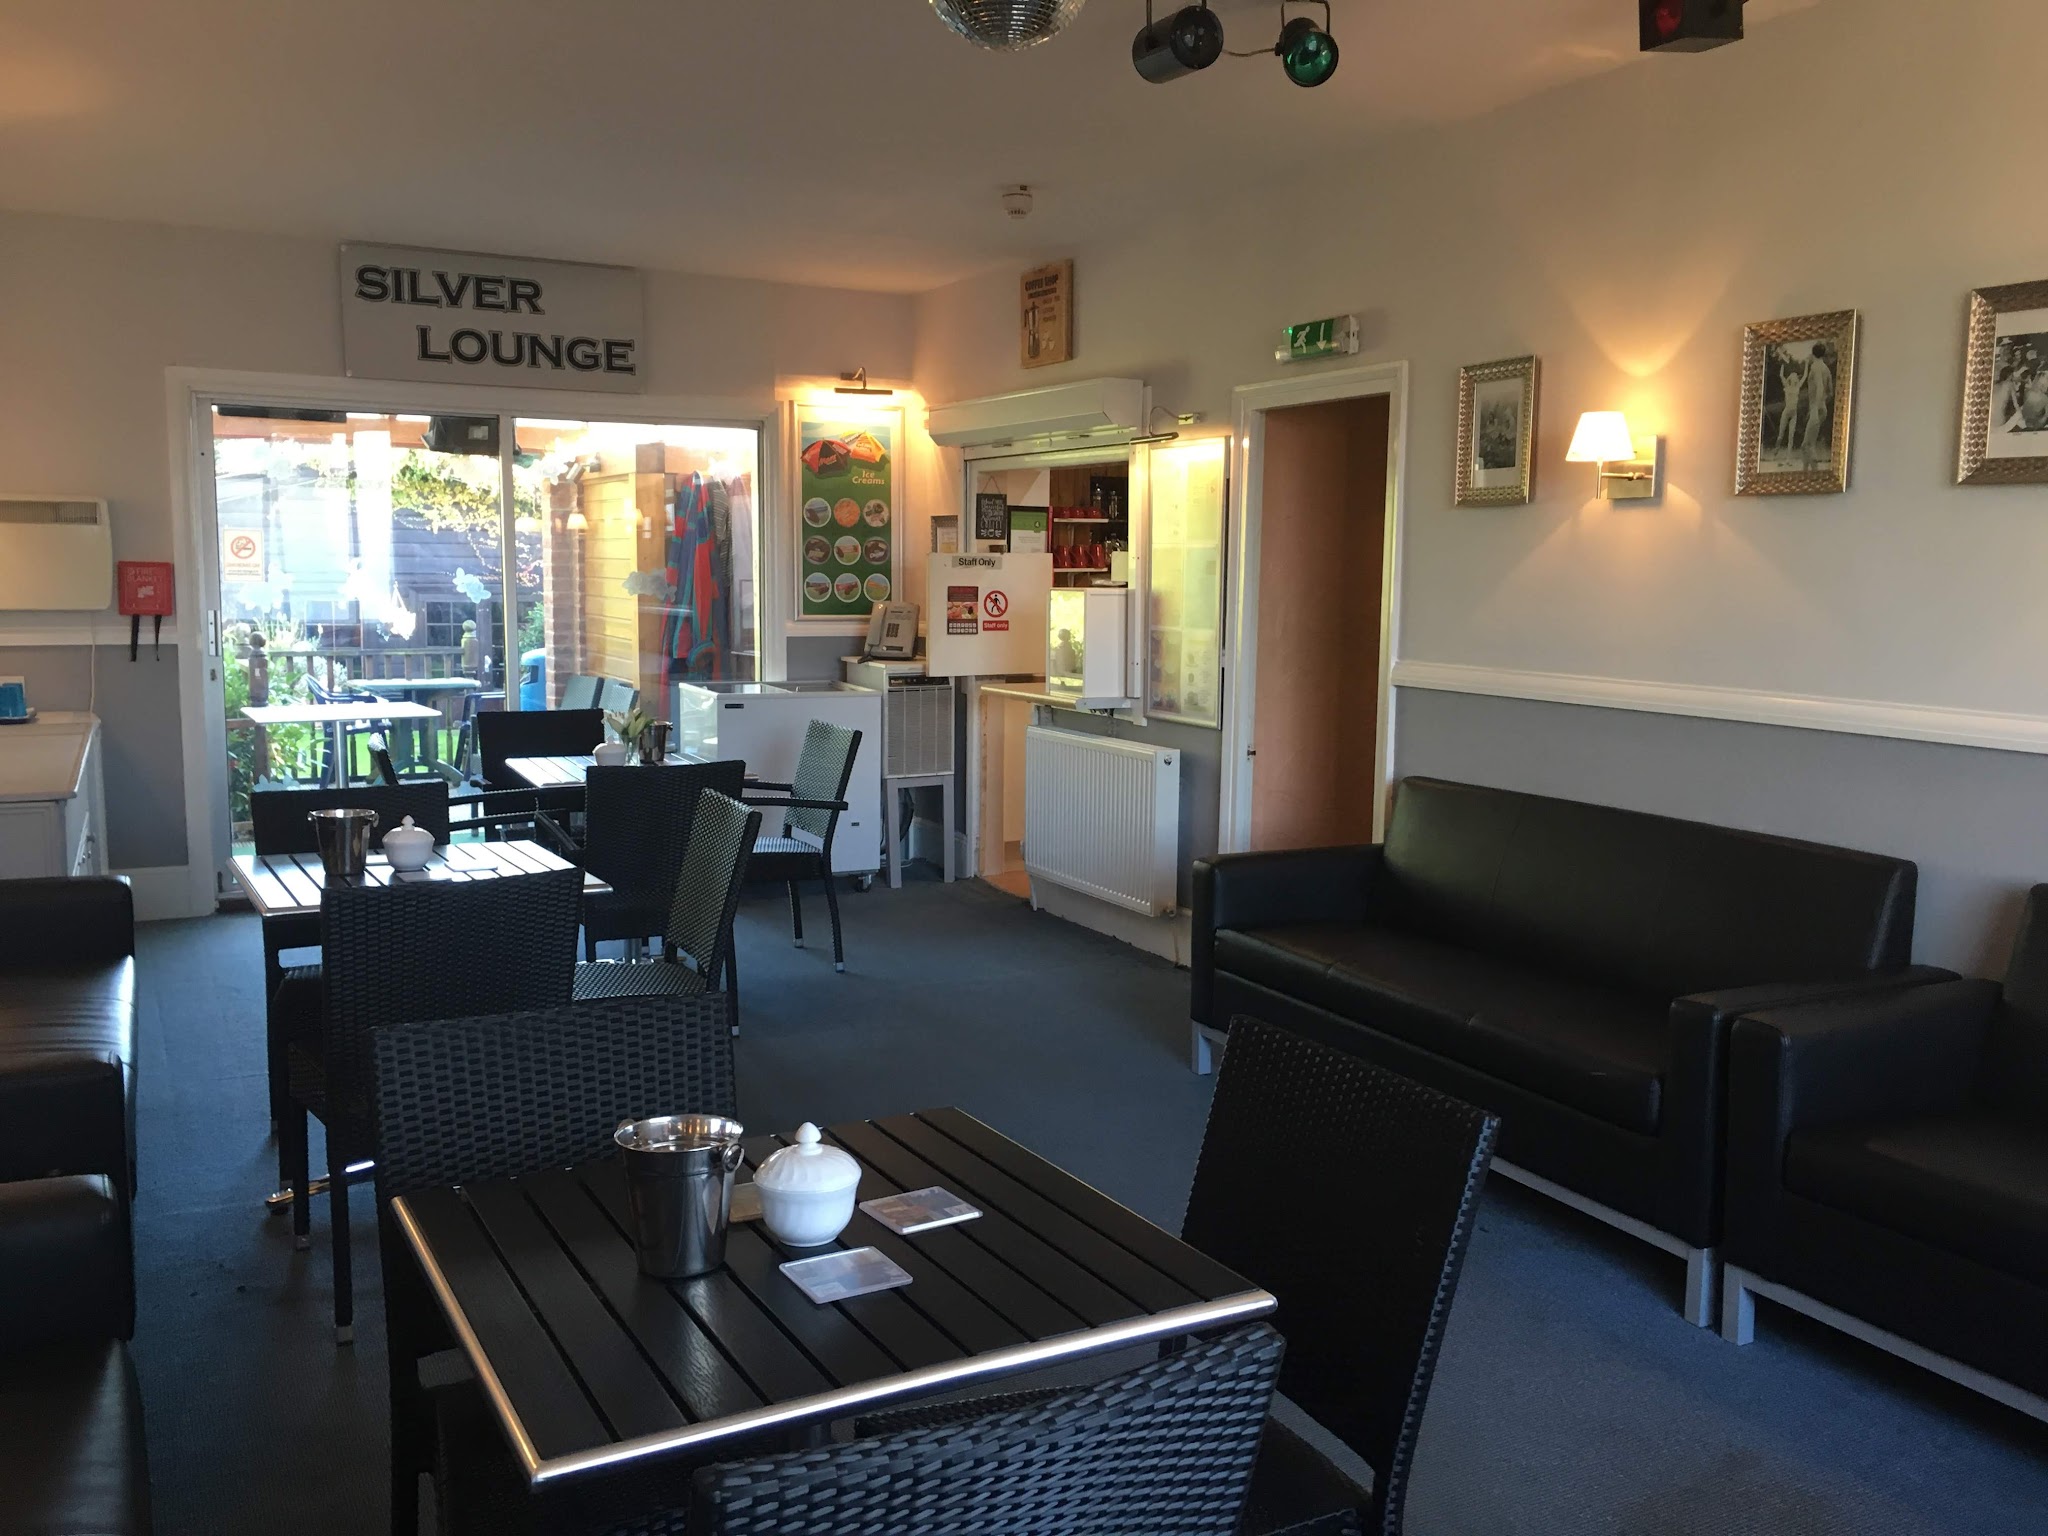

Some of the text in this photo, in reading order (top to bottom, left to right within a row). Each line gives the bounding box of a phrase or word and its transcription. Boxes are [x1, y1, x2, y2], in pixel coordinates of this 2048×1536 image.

[355, 264, 545, 315] SILVER
[416, 325, 636, 375] LOUNGE
[862, 470, 875, 478] Ice
[852, 476, 885, 485] Creams
[958, 557, 996, 568] Staff Only
[983, 621, 1008, 630] Staff only
